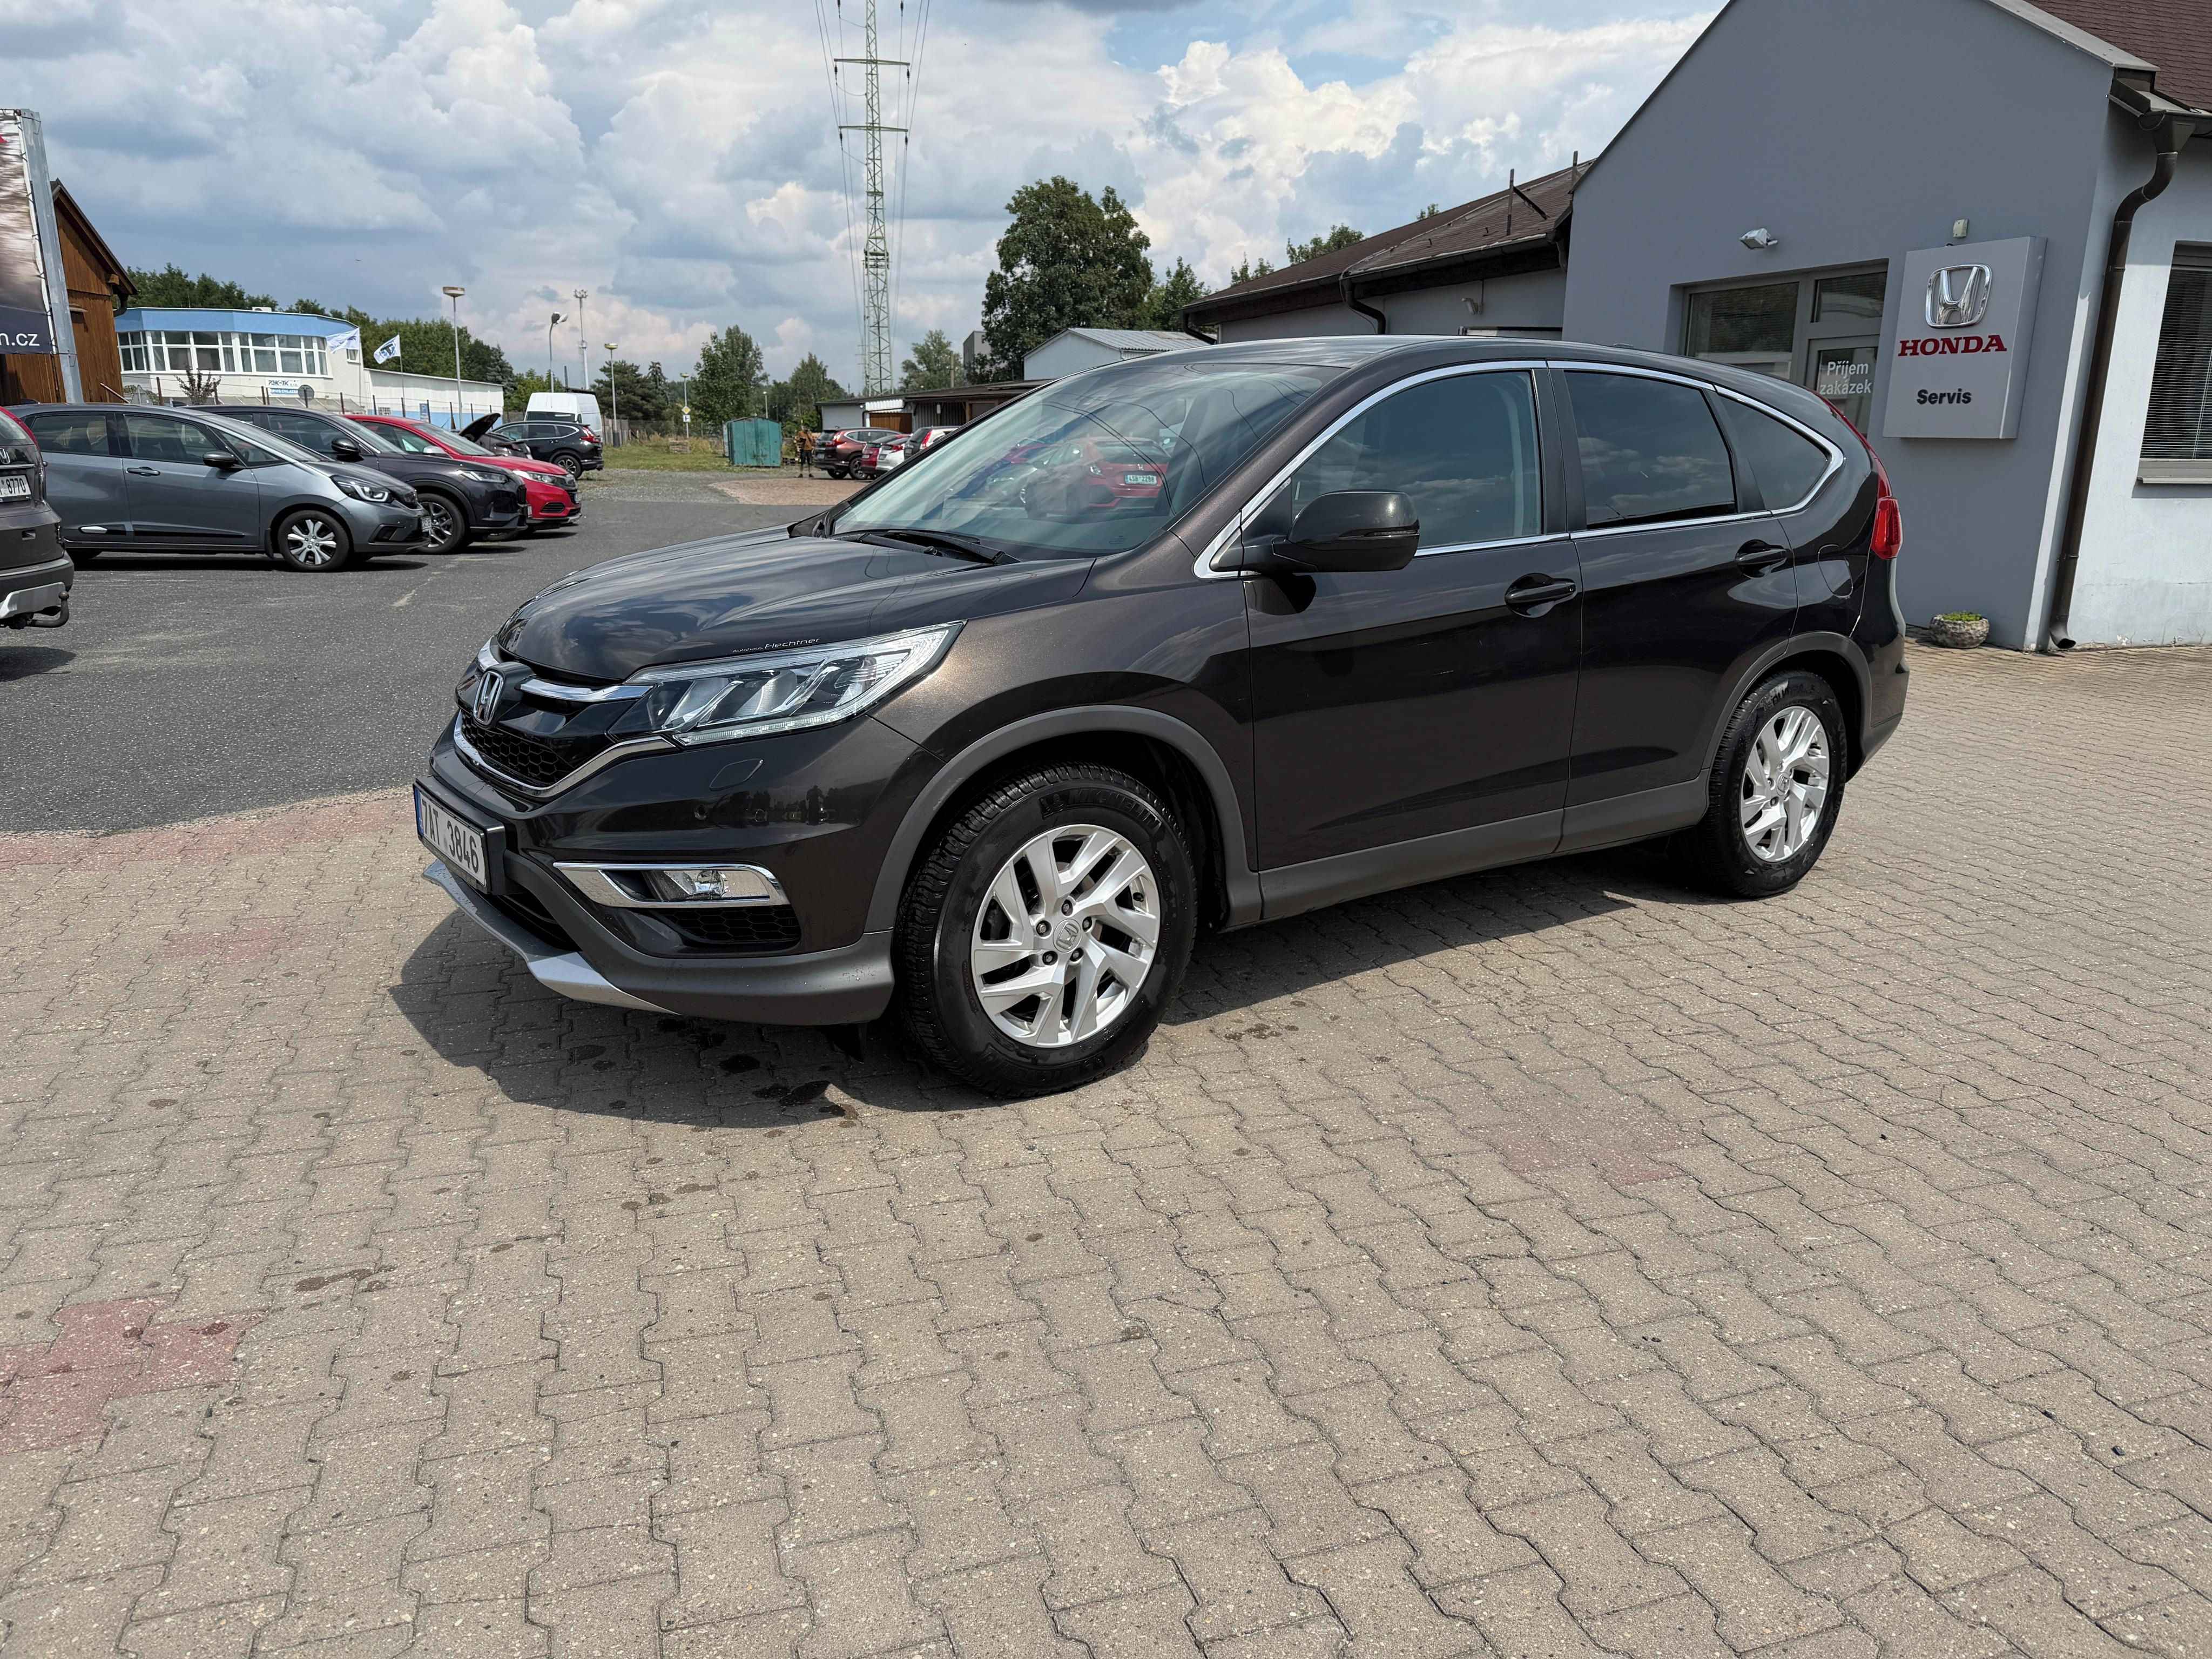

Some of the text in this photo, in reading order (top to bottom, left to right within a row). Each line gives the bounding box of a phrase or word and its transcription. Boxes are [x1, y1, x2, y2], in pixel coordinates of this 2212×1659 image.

[1898, 335, 2007, 357] HONDA
[1827, 360, 1869, 379] Příjem
[1819, 379, 1872, 396] zakázek
[1917, 388, 1972, 404] Servis
[6, 478, 26, 494] 8770
[765, 638, 820, 649] Flechtner
[1068, 788, 1162, 831] MICHELIN
[422, 799, 440, 846] 7AT
[447, 820, 479, 873] 3846
